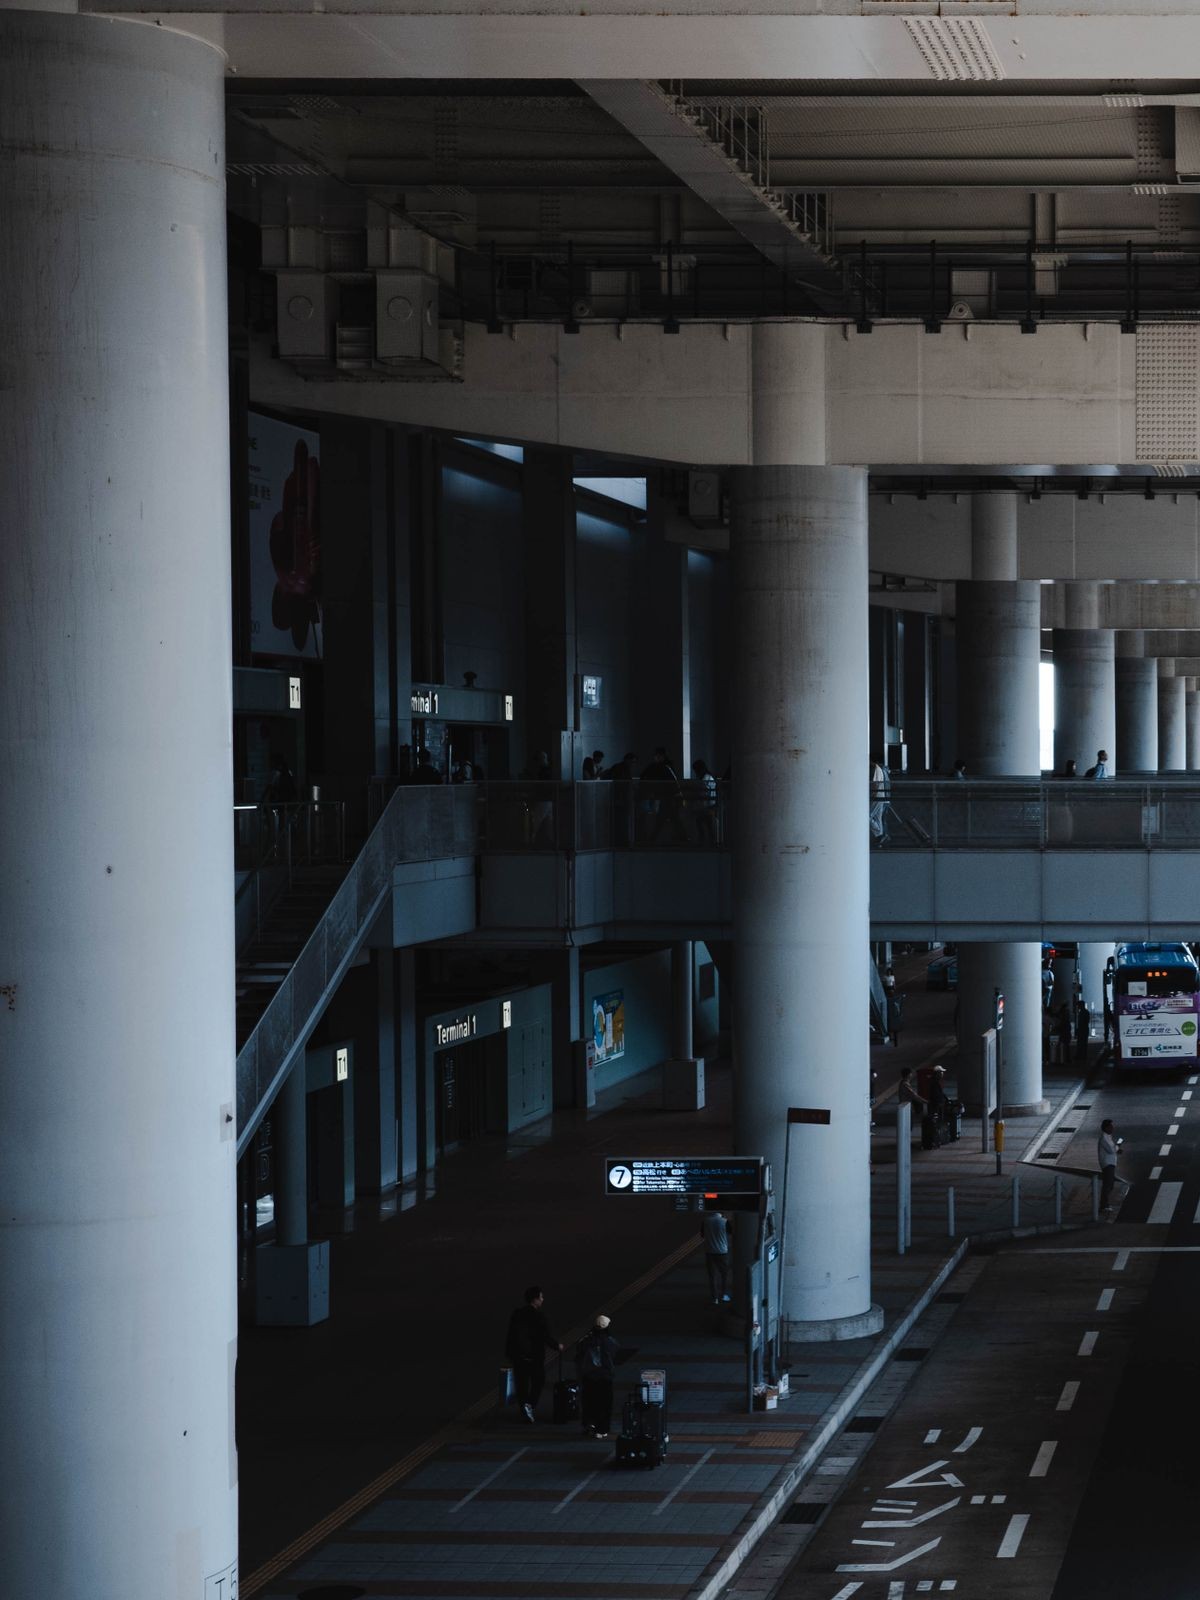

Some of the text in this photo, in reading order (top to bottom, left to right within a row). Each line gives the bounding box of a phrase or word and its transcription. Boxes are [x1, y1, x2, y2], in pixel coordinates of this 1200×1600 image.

[434, 693, 439, 715] 1
[436, 1015, 477, 1045] Terminal 1
[615, 1169, 626, 1185] 7
